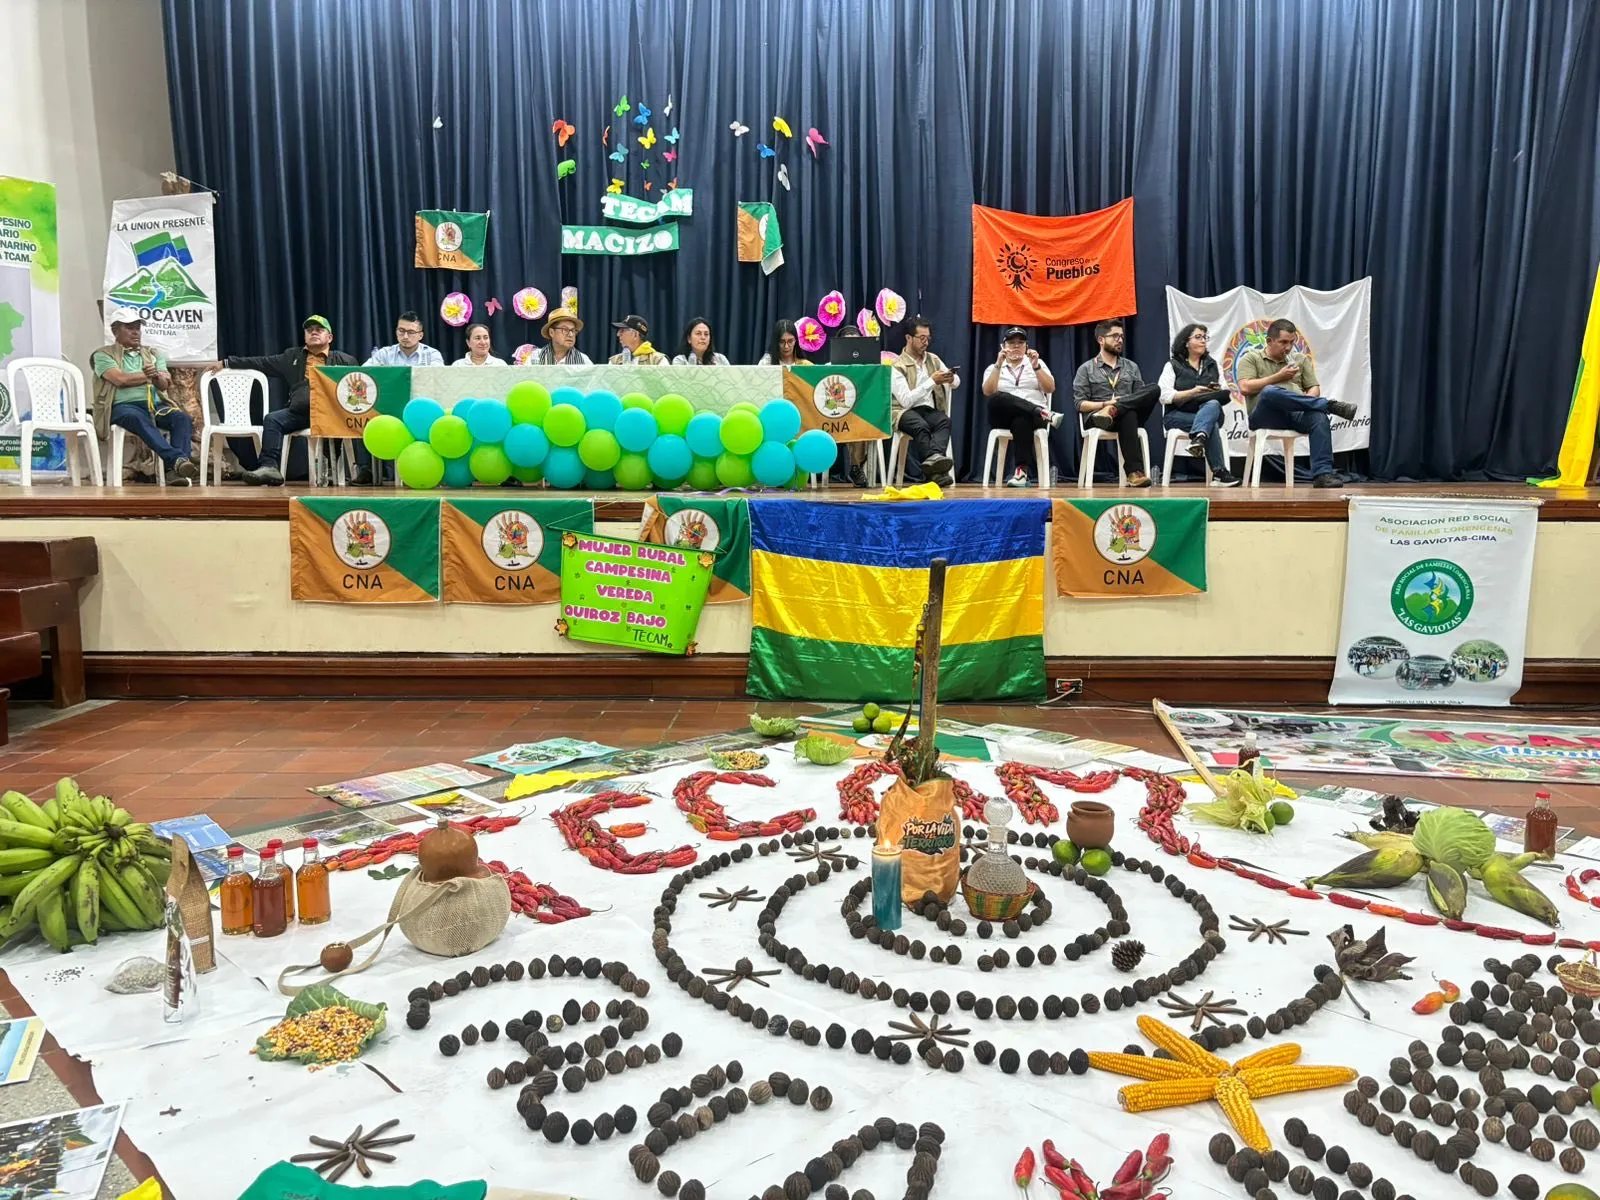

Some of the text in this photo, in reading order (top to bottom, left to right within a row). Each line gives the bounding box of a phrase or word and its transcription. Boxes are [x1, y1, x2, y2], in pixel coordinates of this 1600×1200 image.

[601, 193, 692, 220] TECAM
[117, 216, 206, 232] LA UNION PRESENTE
[562, 229, 673, 252] MACIZO
[436, 252, 458, 264] CNA
[1045, 257, 1085, 268] Congreso
[1046, 263, 1101, 281] Pueblos
[130, 307, 203, 324] OCAVEN
[821, 420, 851, 434] CNA
[1379, 514, 1511, 526] ASOCIACION RED SOCIAL
[1391, 528, 1441, 537] FAMILIAS
[1413, 534, 1497, 546] GAVIOTAS-CIMA
[578, 538, 687, 567] MUJER RURAL
[585, 560, 672, 583] CAMPESINA
[1103, 569, 1145, 585] CNA
[342, 573, 384, 590] CNA
[494, 575, 536, 591] CNA
[595, 584, 655, 604] VEREDA
[563, 603, 667, 629] QUIROZ BAJO
[924, 822, 937, 834] LA
